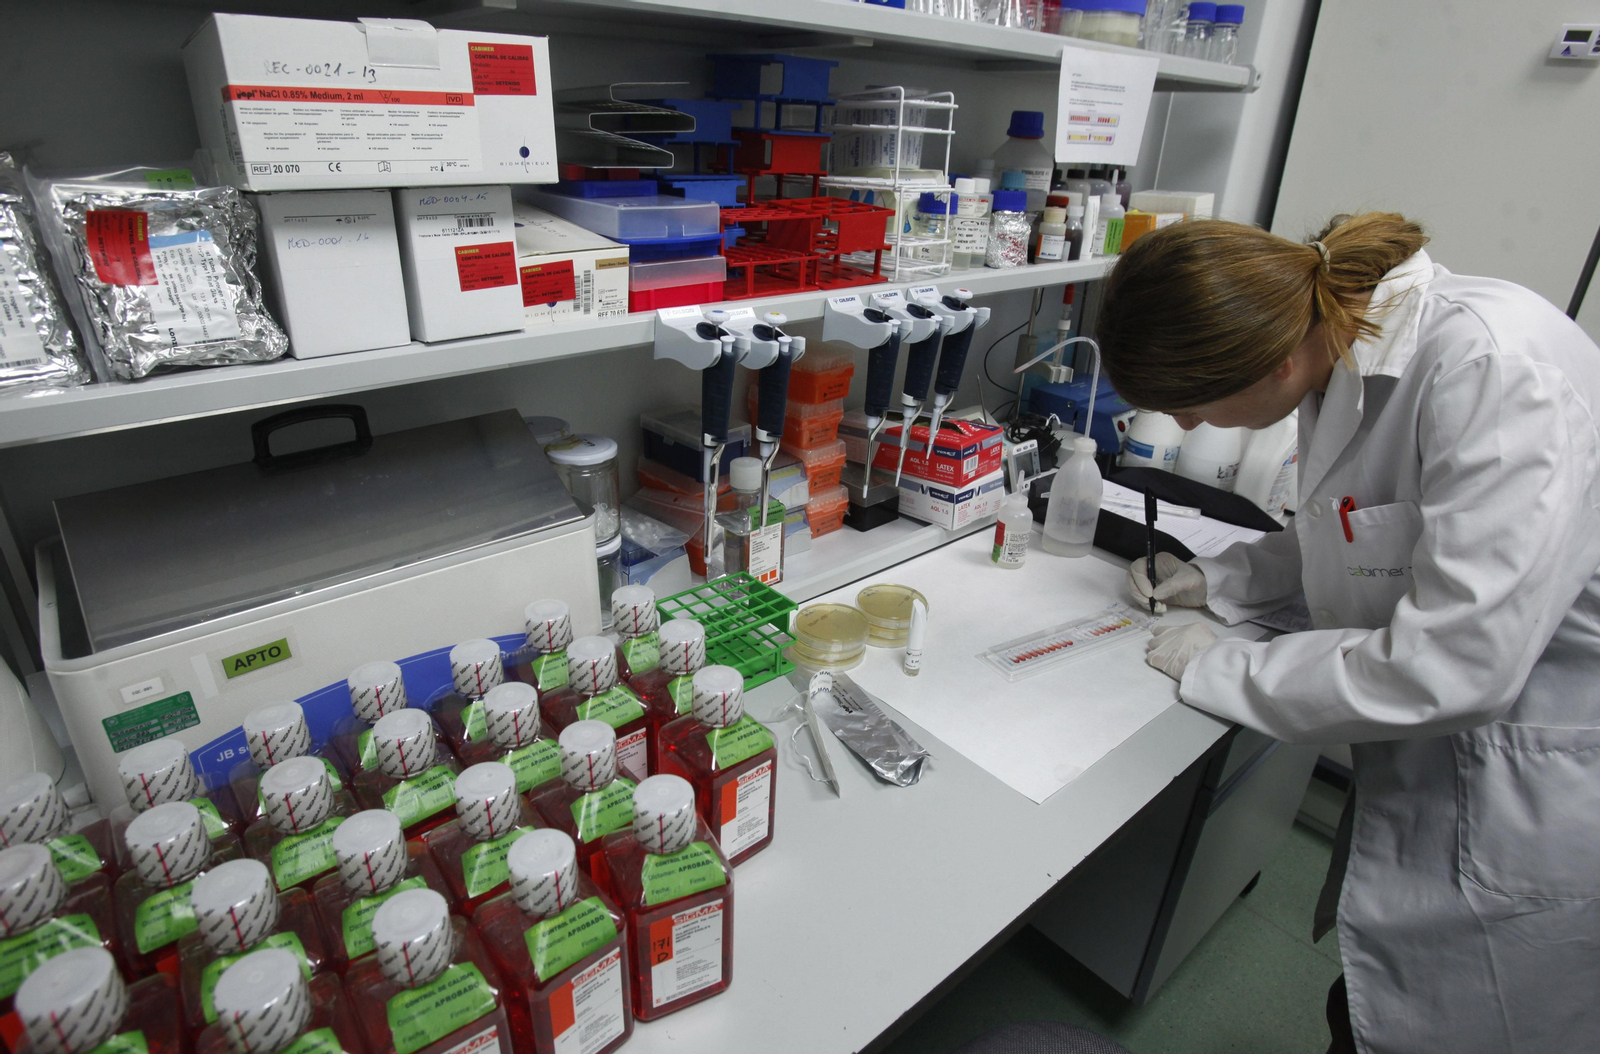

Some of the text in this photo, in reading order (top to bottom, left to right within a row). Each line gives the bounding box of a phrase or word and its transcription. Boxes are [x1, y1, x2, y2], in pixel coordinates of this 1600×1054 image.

[260, 90, 280, 98] NaCl
[283, 91, 307, 99] 0.85%
[310, 92, 345, 101] Medium,
[273, 165, 283, 173] 20
[286, 165, 300, 173] 070
[937, 463, 954, 471] LATEX
[959, 502, 971, 511] LATEX
[1347, 566, 1404, 577] cabimer
[234, 645, 281, 671] APTO
[720, 730, 736, 739] CONTROL
[737, 727, 762, 742] APROBADO
[216, 749, 234, 762] JB
[738, 766, 769, 786] SIGMA
[285, 837, 311, 851] CONTROL
[655, 858, 681, 868] CONTROL
[678, 859, 715, 873] APROBADO
[542, 923, 568, 937] CONTROL
[577, 905, 600, 919] CALIDAD
[674, 905, 718, 923] SIGMA
[567, 915, 605, 938] APROBADO
[574, 956, 617, 986] SIGMA
[405, 990, 437, 1009] CONTROL
[448, 971, 474, 987] CALIDAD
[435, 982, 480, 1008] APROBADO
